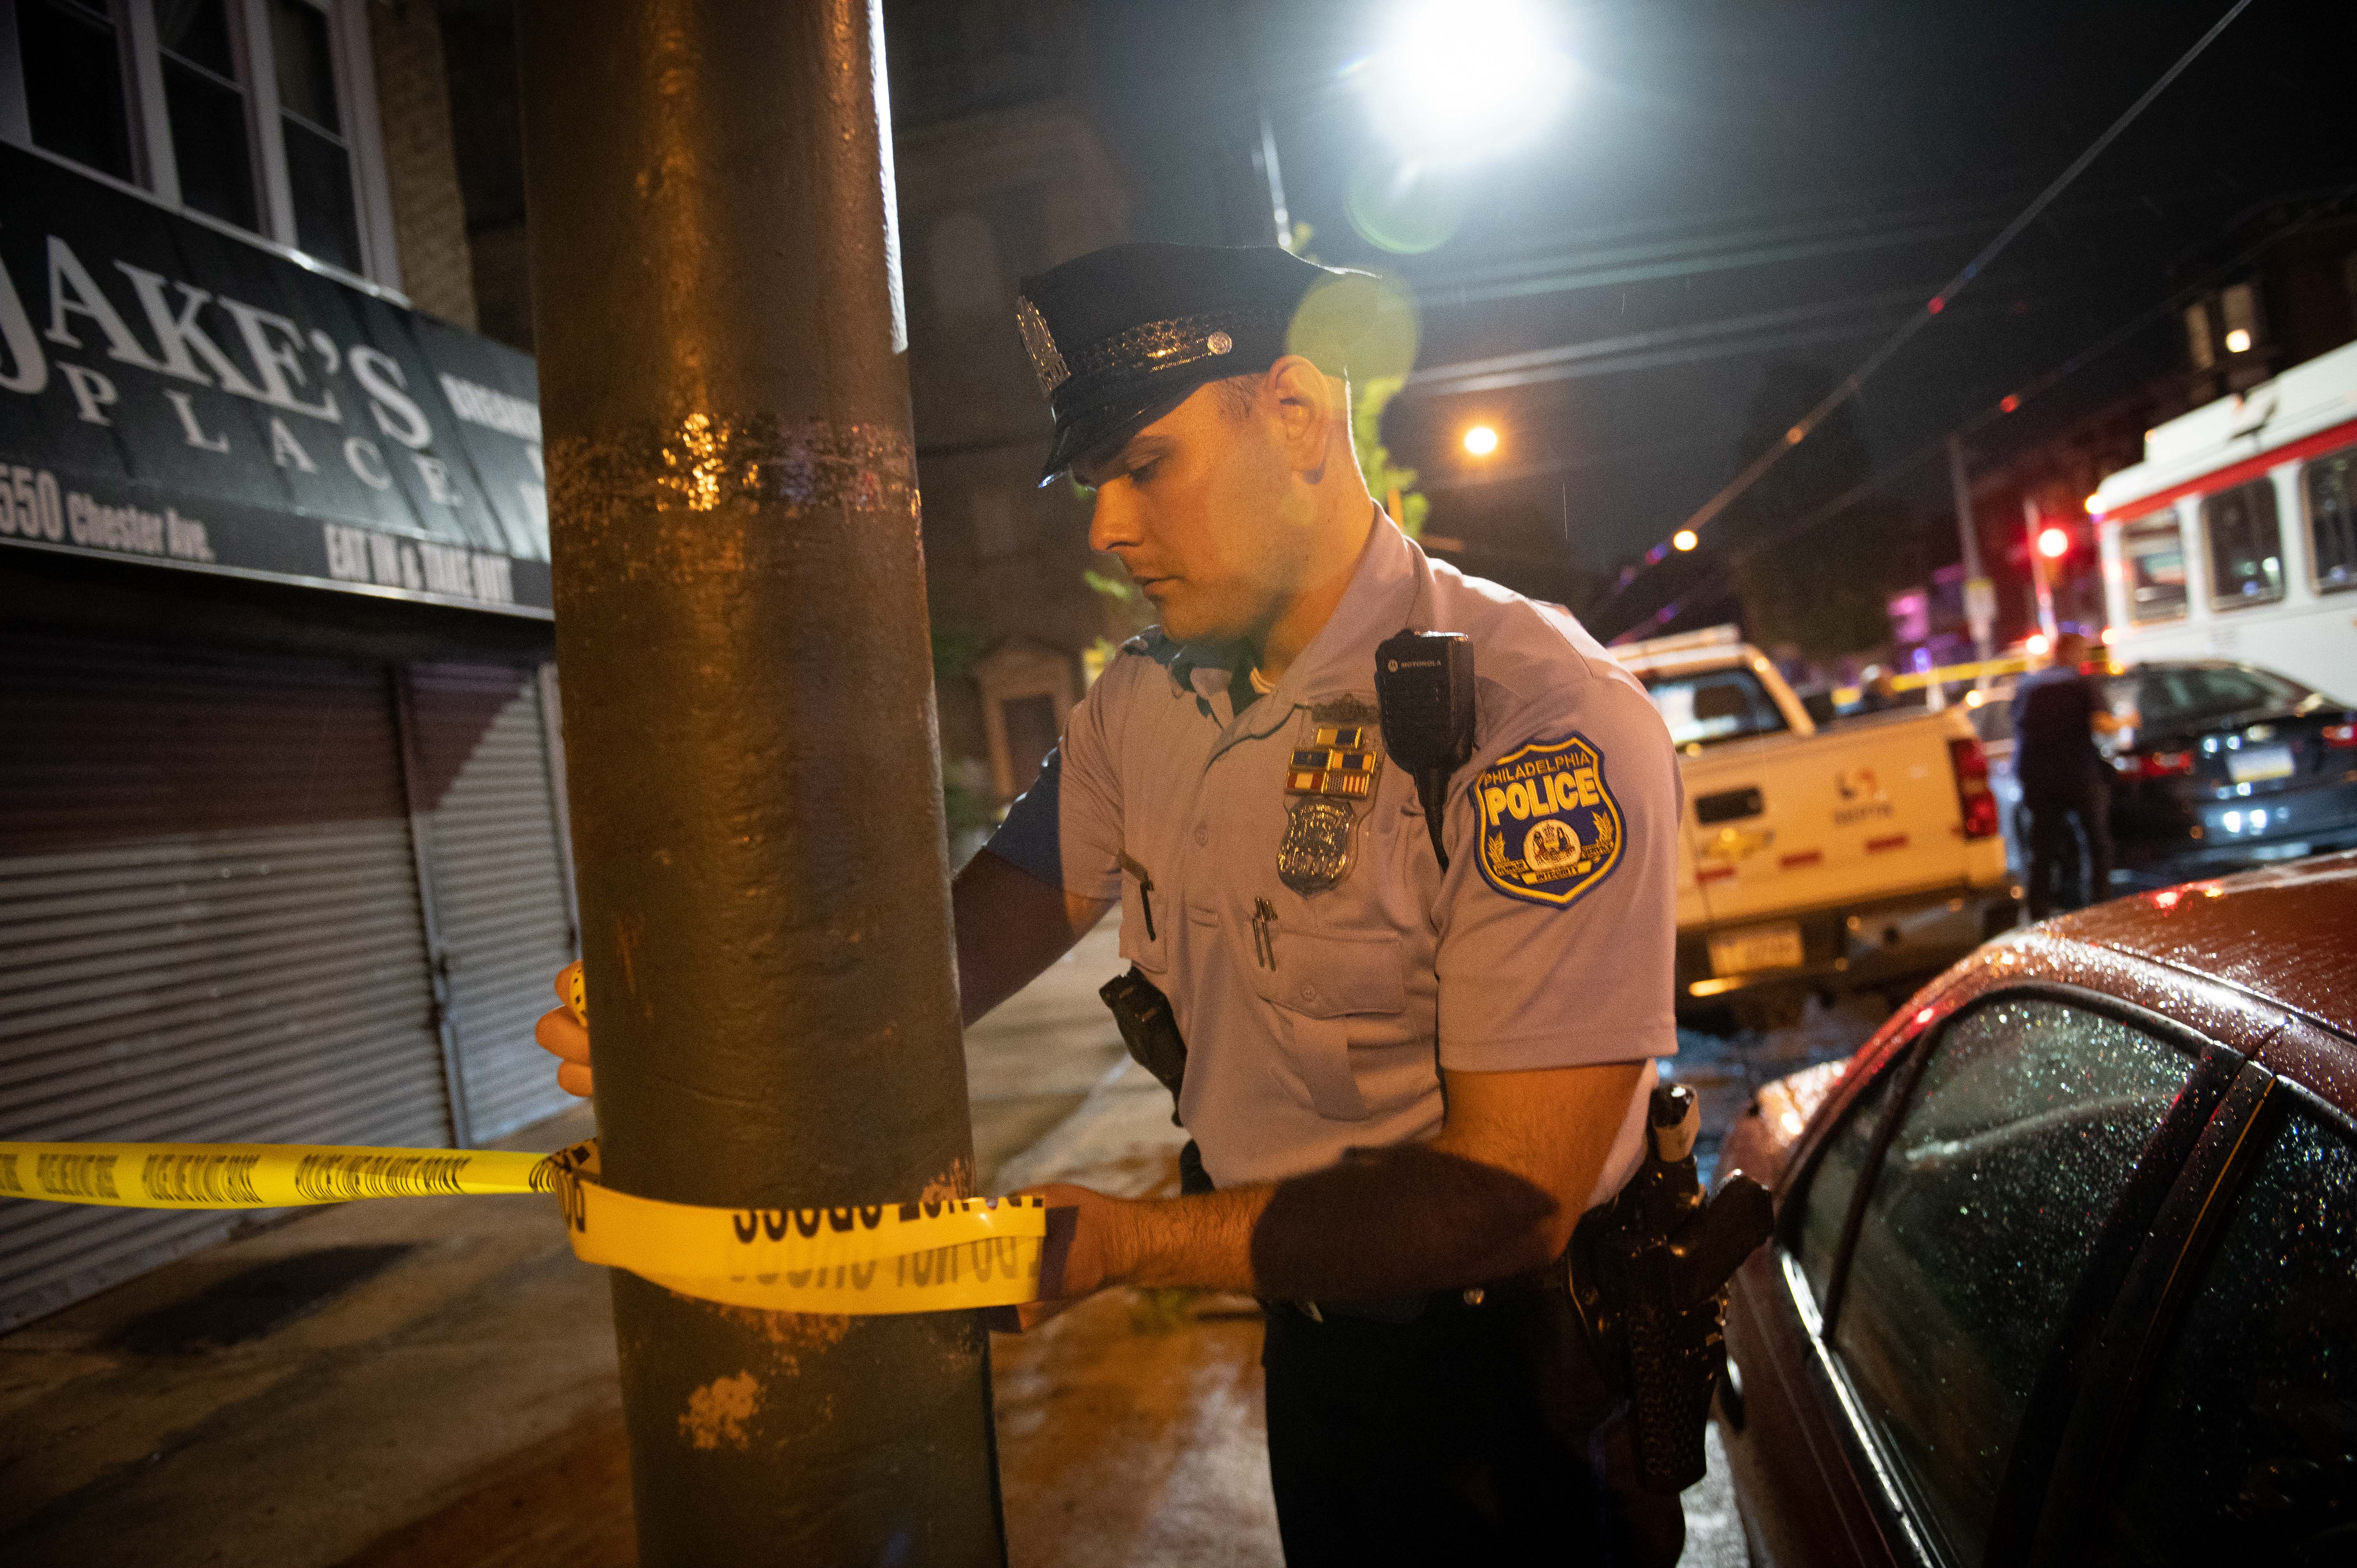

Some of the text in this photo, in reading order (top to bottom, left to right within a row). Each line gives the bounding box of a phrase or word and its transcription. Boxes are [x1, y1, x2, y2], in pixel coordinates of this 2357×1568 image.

[55, 359, 464, 508] PLACE
[1484, 751, 1591, 786] PHILADELPHIA
[1484, 767, 1599, 826] POLICE
[1536, 865, 1578, 881] INTEGRITY
